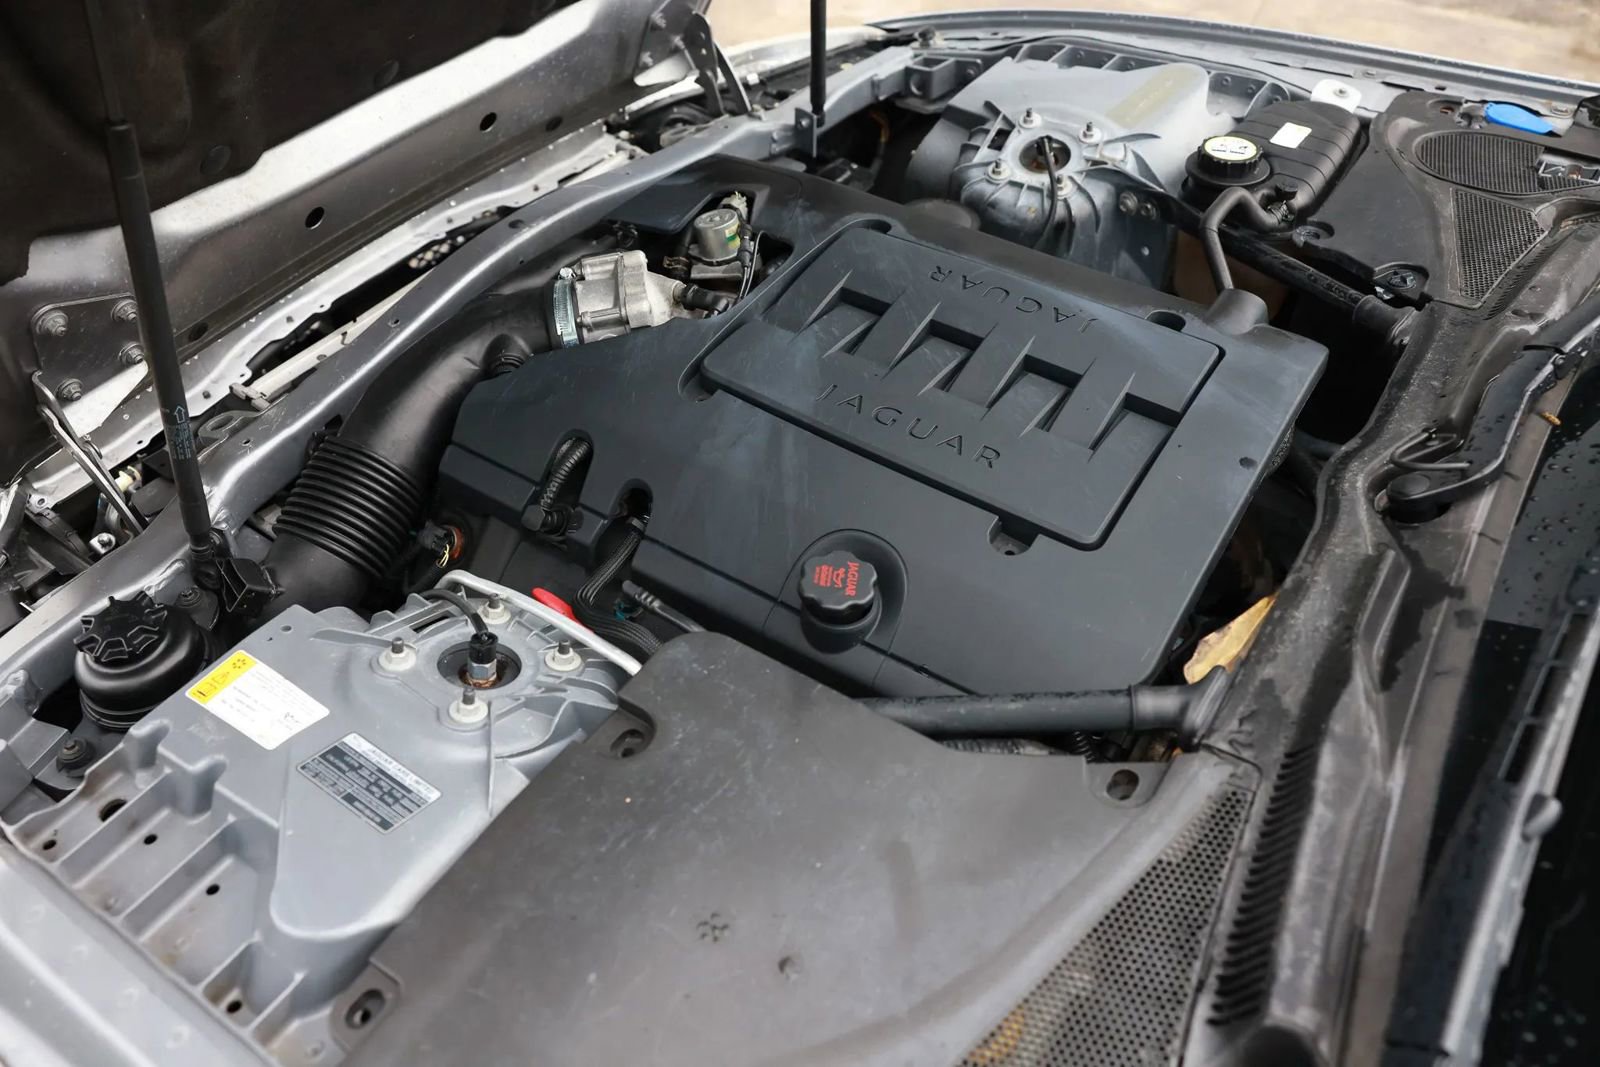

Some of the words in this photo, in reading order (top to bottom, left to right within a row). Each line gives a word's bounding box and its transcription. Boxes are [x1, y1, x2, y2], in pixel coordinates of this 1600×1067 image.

[928, 265, 1099, 333] JAGUAR
[815, 383, 1002, 469] JAGUAR
[846, 561, 860, 596] JAGUAR
[368, 747, 394, 765] JAGUAR
